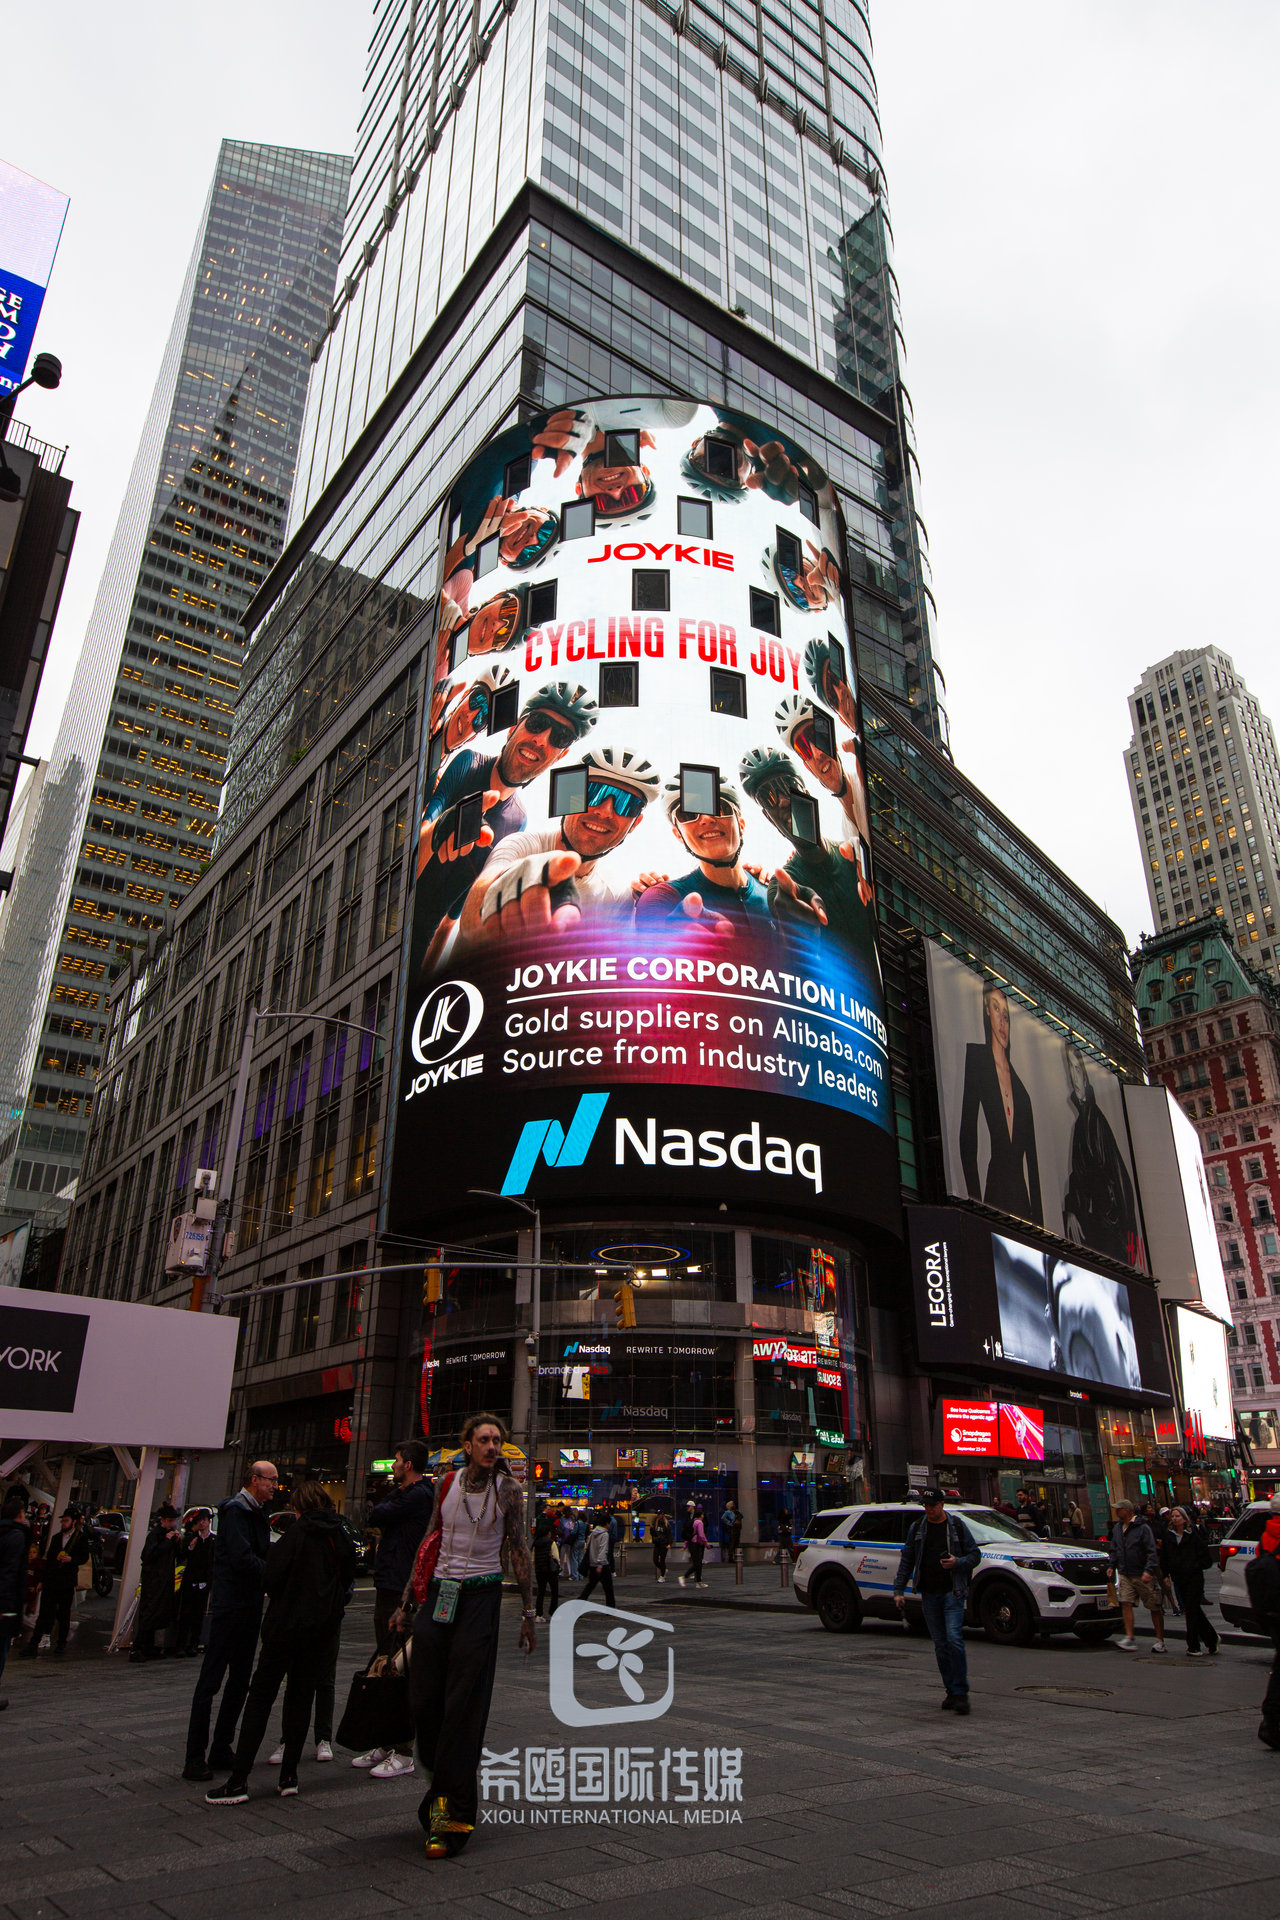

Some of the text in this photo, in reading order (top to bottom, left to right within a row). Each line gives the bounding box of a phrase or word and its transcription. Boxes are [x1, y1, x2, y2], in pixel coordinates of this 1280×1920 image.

[588, 542, 734, 572] JOYKIE
[524, 616, 802, 691] CYCLING FOR JOY
[506, 956, 888, 1047] JOYKIE CORPORATION LIMITED
[505, 1003, 883, 1081] Gold suppliers on Alibaba.com
[405, 1053, 484, 1102] JOYKIE
[502, 1039, 879, 1108] Source from industry leaders
[615, 1117, 823, 1194] Nasdaq
[924, 1241, 947, 1327] LEGORA
[445, 1355, 468, 1365] REWRITE
[470, 1351, 506, 1362] TOMORROW
[579, 1344, 716, 1356] Nasdaq REWRITE TOMORROW
[623, 1404, 669, 1419] Nasdaq
[983, 1552, 1004, 1560] POLICE
